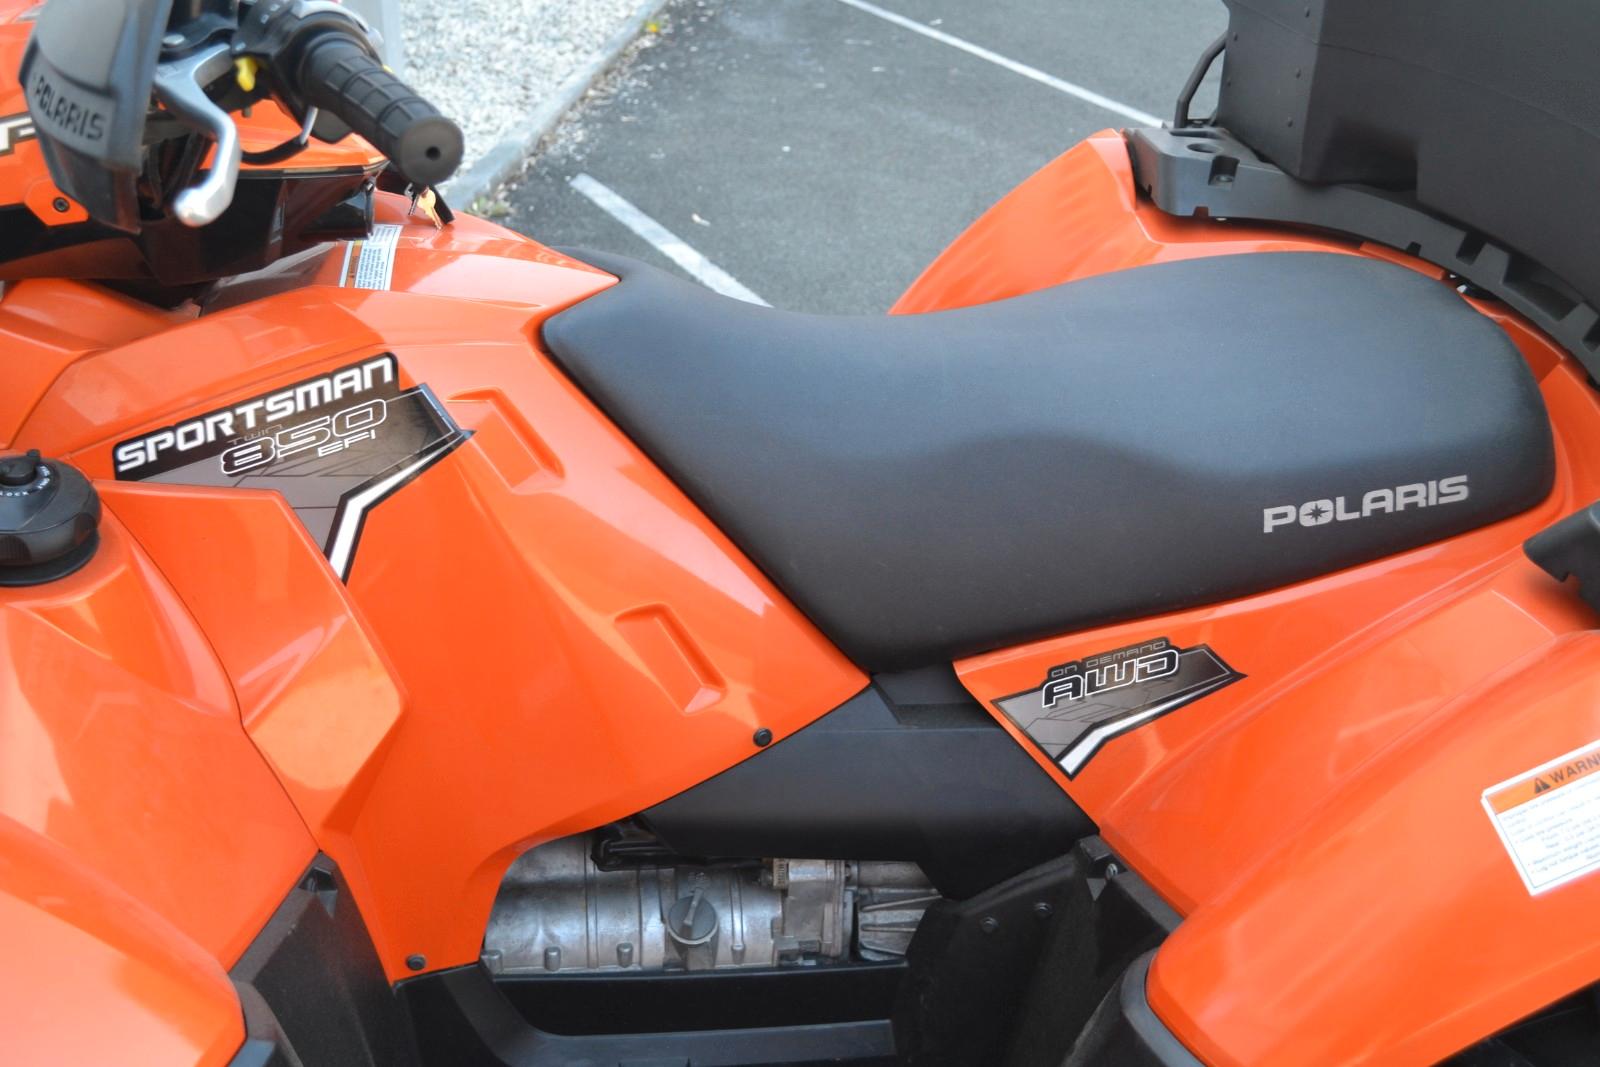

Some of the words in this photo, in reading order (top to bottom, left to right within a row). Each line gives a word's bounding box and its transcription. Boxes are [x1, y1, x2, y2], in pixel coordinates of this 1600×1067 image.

[34, 75, 105, 140] POLARIS
[117, 356, 393, 472] SPORTSMAN
[221, 399, 387, 475] 850
[317, 429, 376, 457] EFI
[1263, 475, 1469, 533] POLARIS
[1042, 649, 1179, 709] AWD
[1051, 664, 1077, 679] ON
[1086, 640, 1167, 669] DEMAND
